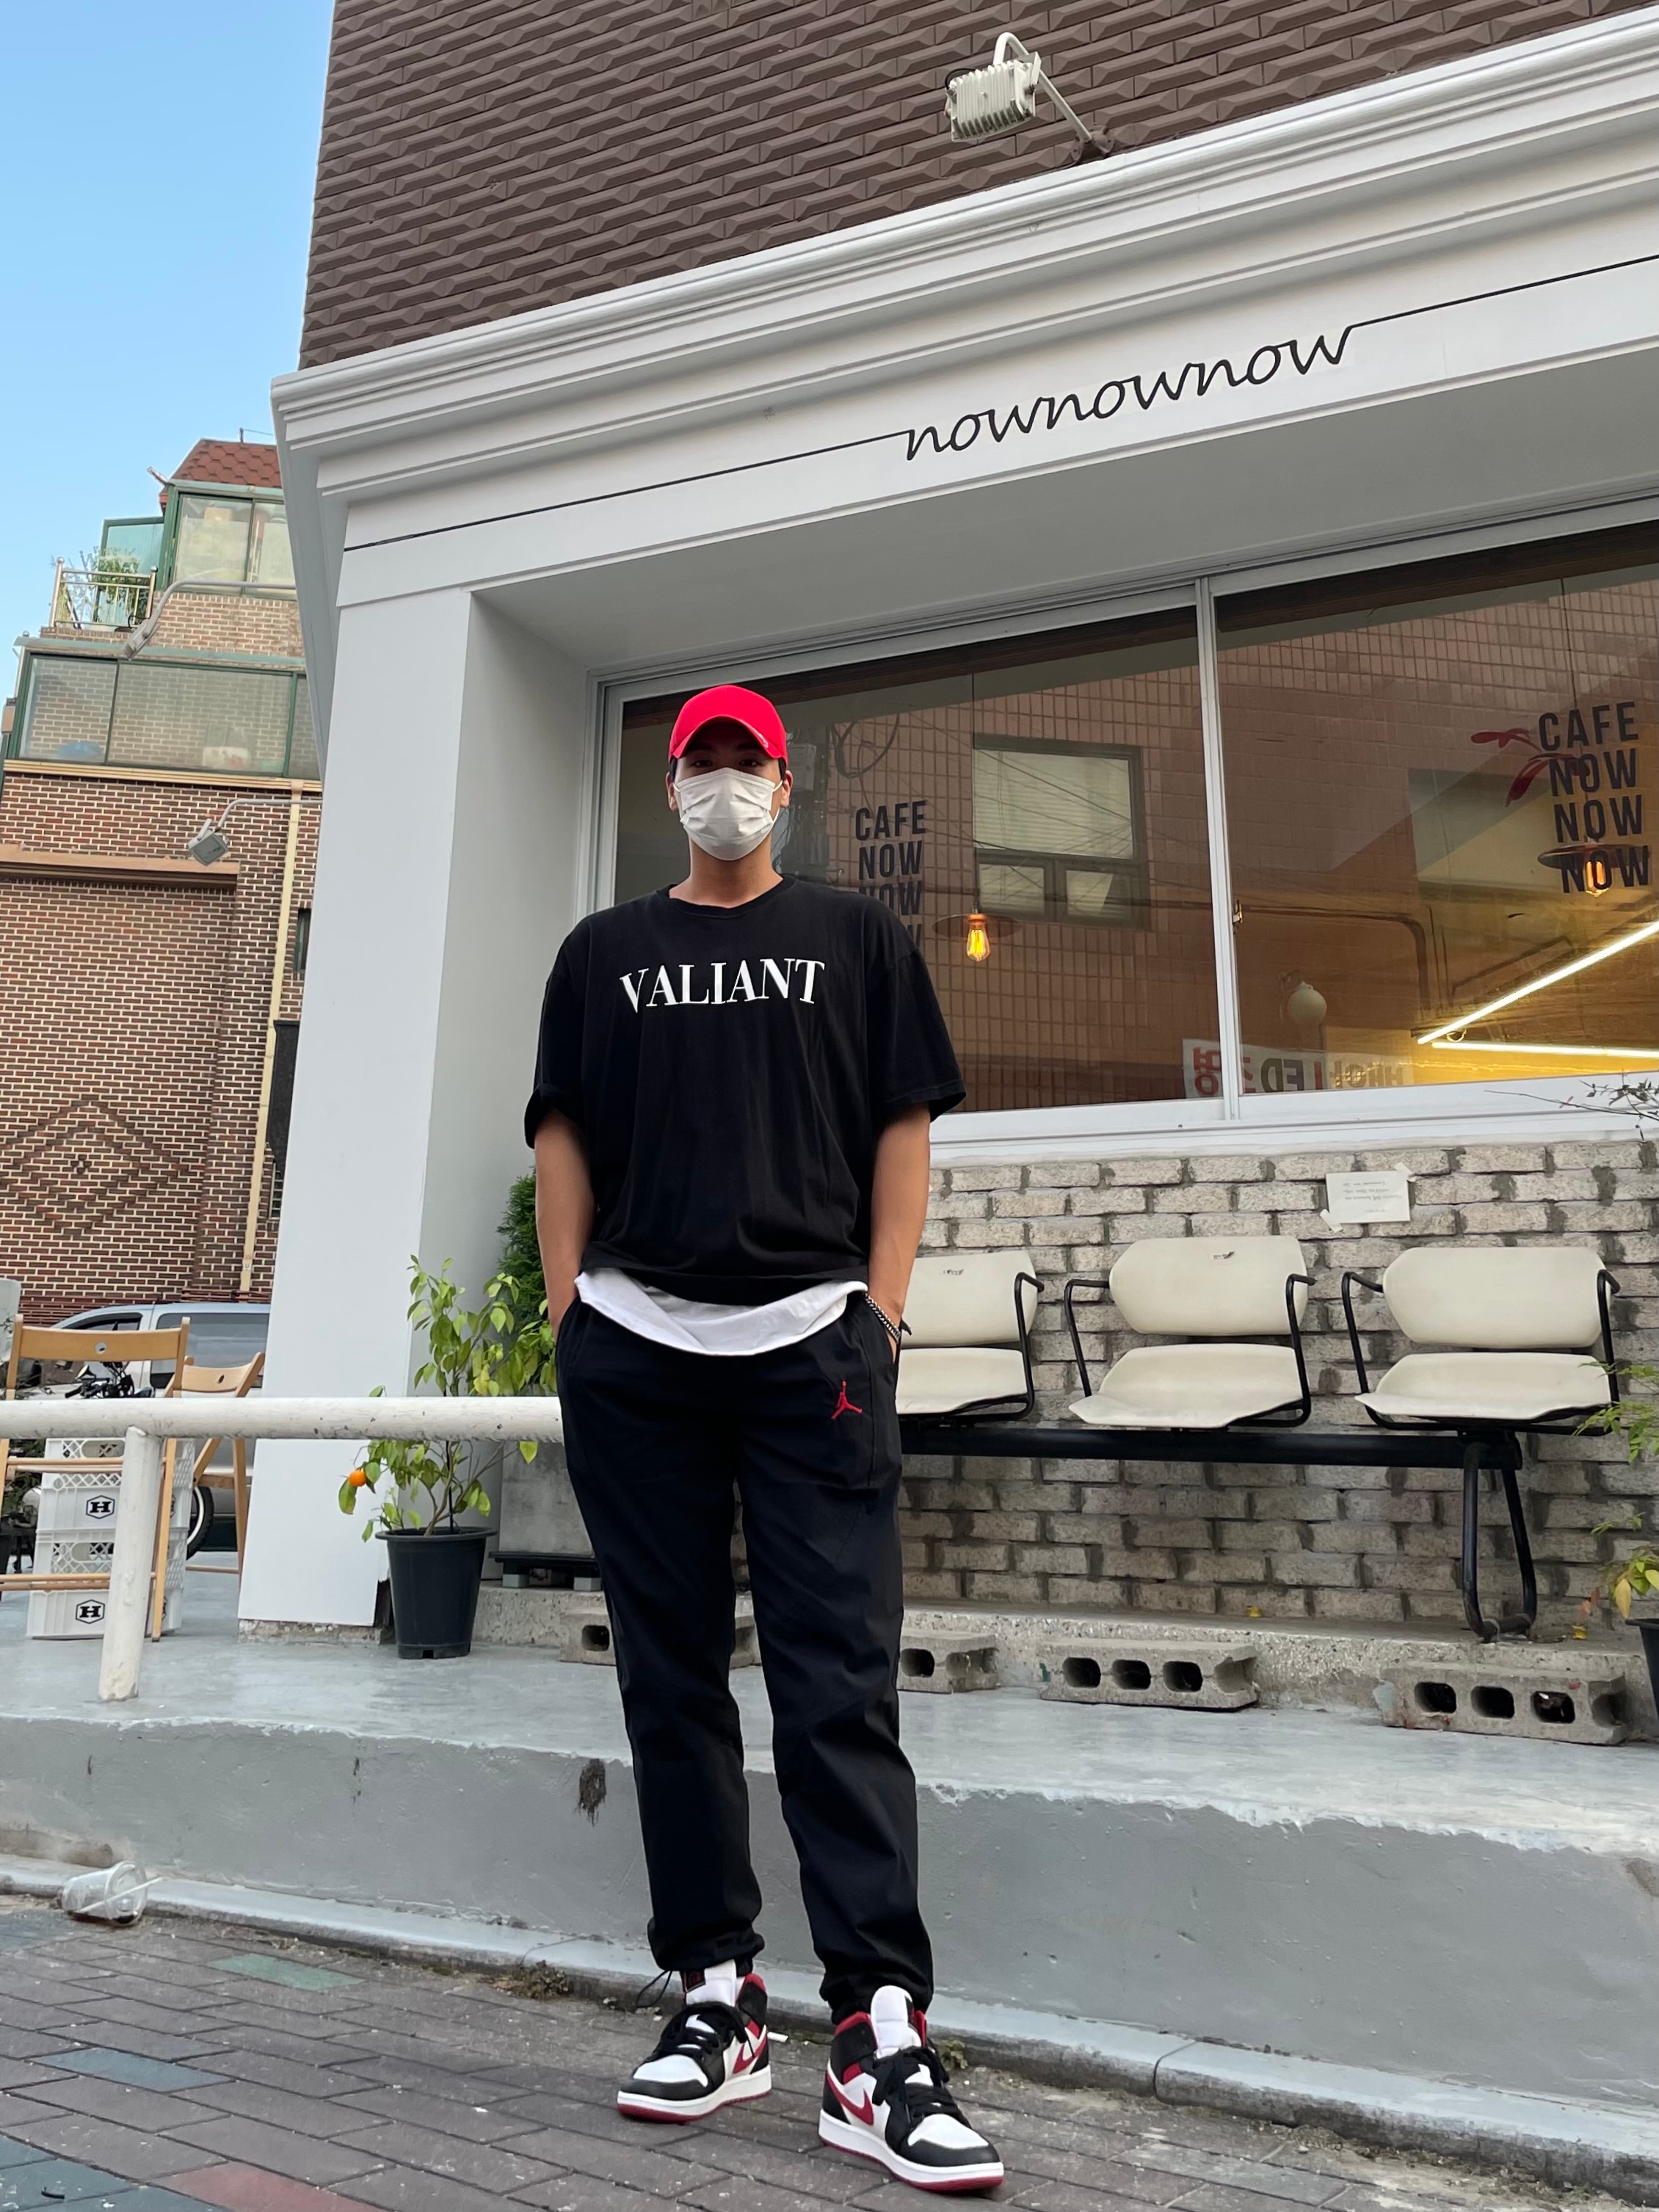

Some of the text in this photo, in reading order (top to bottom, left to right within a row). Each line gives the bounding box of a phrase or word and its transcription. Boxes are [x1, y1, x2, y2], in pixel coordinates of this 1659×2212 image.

[907, 325, 1355, 460] nownownow
[1539, 701, 1638, 752] CAFE
[1549, 748, 1637, 796] NOW
[855, 800, 926, 840] CAFE
[1554, 794, 1643, 843] NOW
[859, 840, 923, 880] NOW
[1560, 845, 1649, 893] NOW
[619, 958, 825, 1013] VALIANT
[89, 1501, 112, 1513] H
[79, 1605, 101, 1618] H
